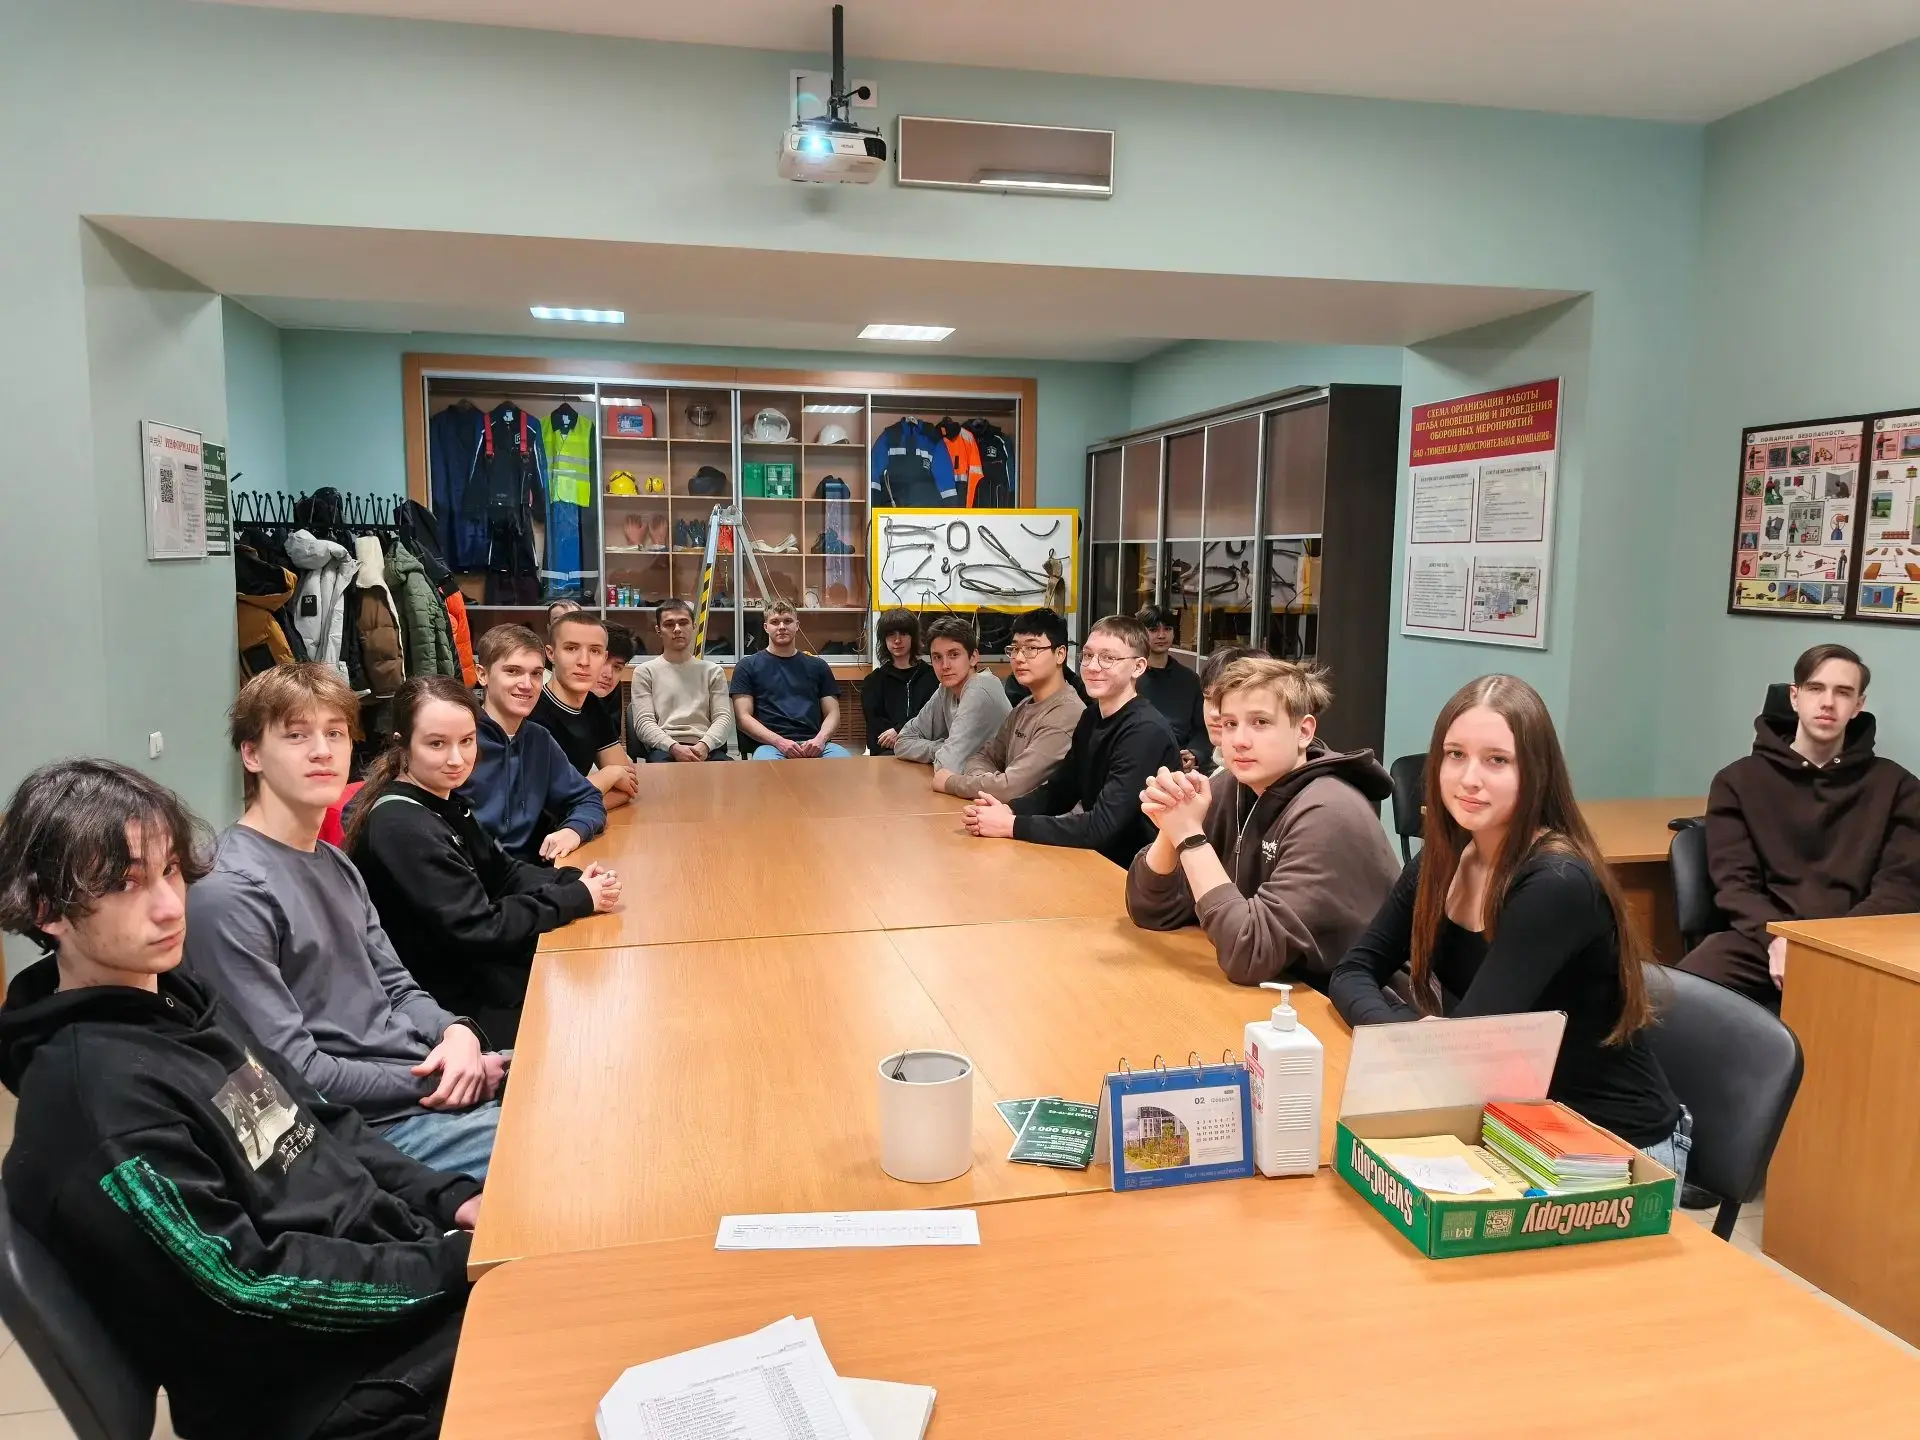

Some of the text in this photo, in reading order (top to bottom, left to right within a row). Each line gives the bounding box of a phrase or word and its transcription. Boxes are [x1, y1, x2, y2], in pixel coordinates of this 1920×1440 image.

[1415, 399, 1553, 432] ШТАБА ОПОВЕЩЕНИЯ И ПРОВЕДЕНИЯ
[1427, 389, 1540, 419] СХЕМА ОРГАНИЗАЦИИ РАБОТЫ
[1430, 415, 1534, 441] ОБОРОННЫХ МЕРОПРИЯТИЙ
[1760, 429, 1845, 443] ПОЖАРНАЯ БЕЗОПАСНОСТЬ
[1350, 1138, 1413, 1226] SvetoCopy
[1520, 1196, 1634, 1236] SvetoCopy
